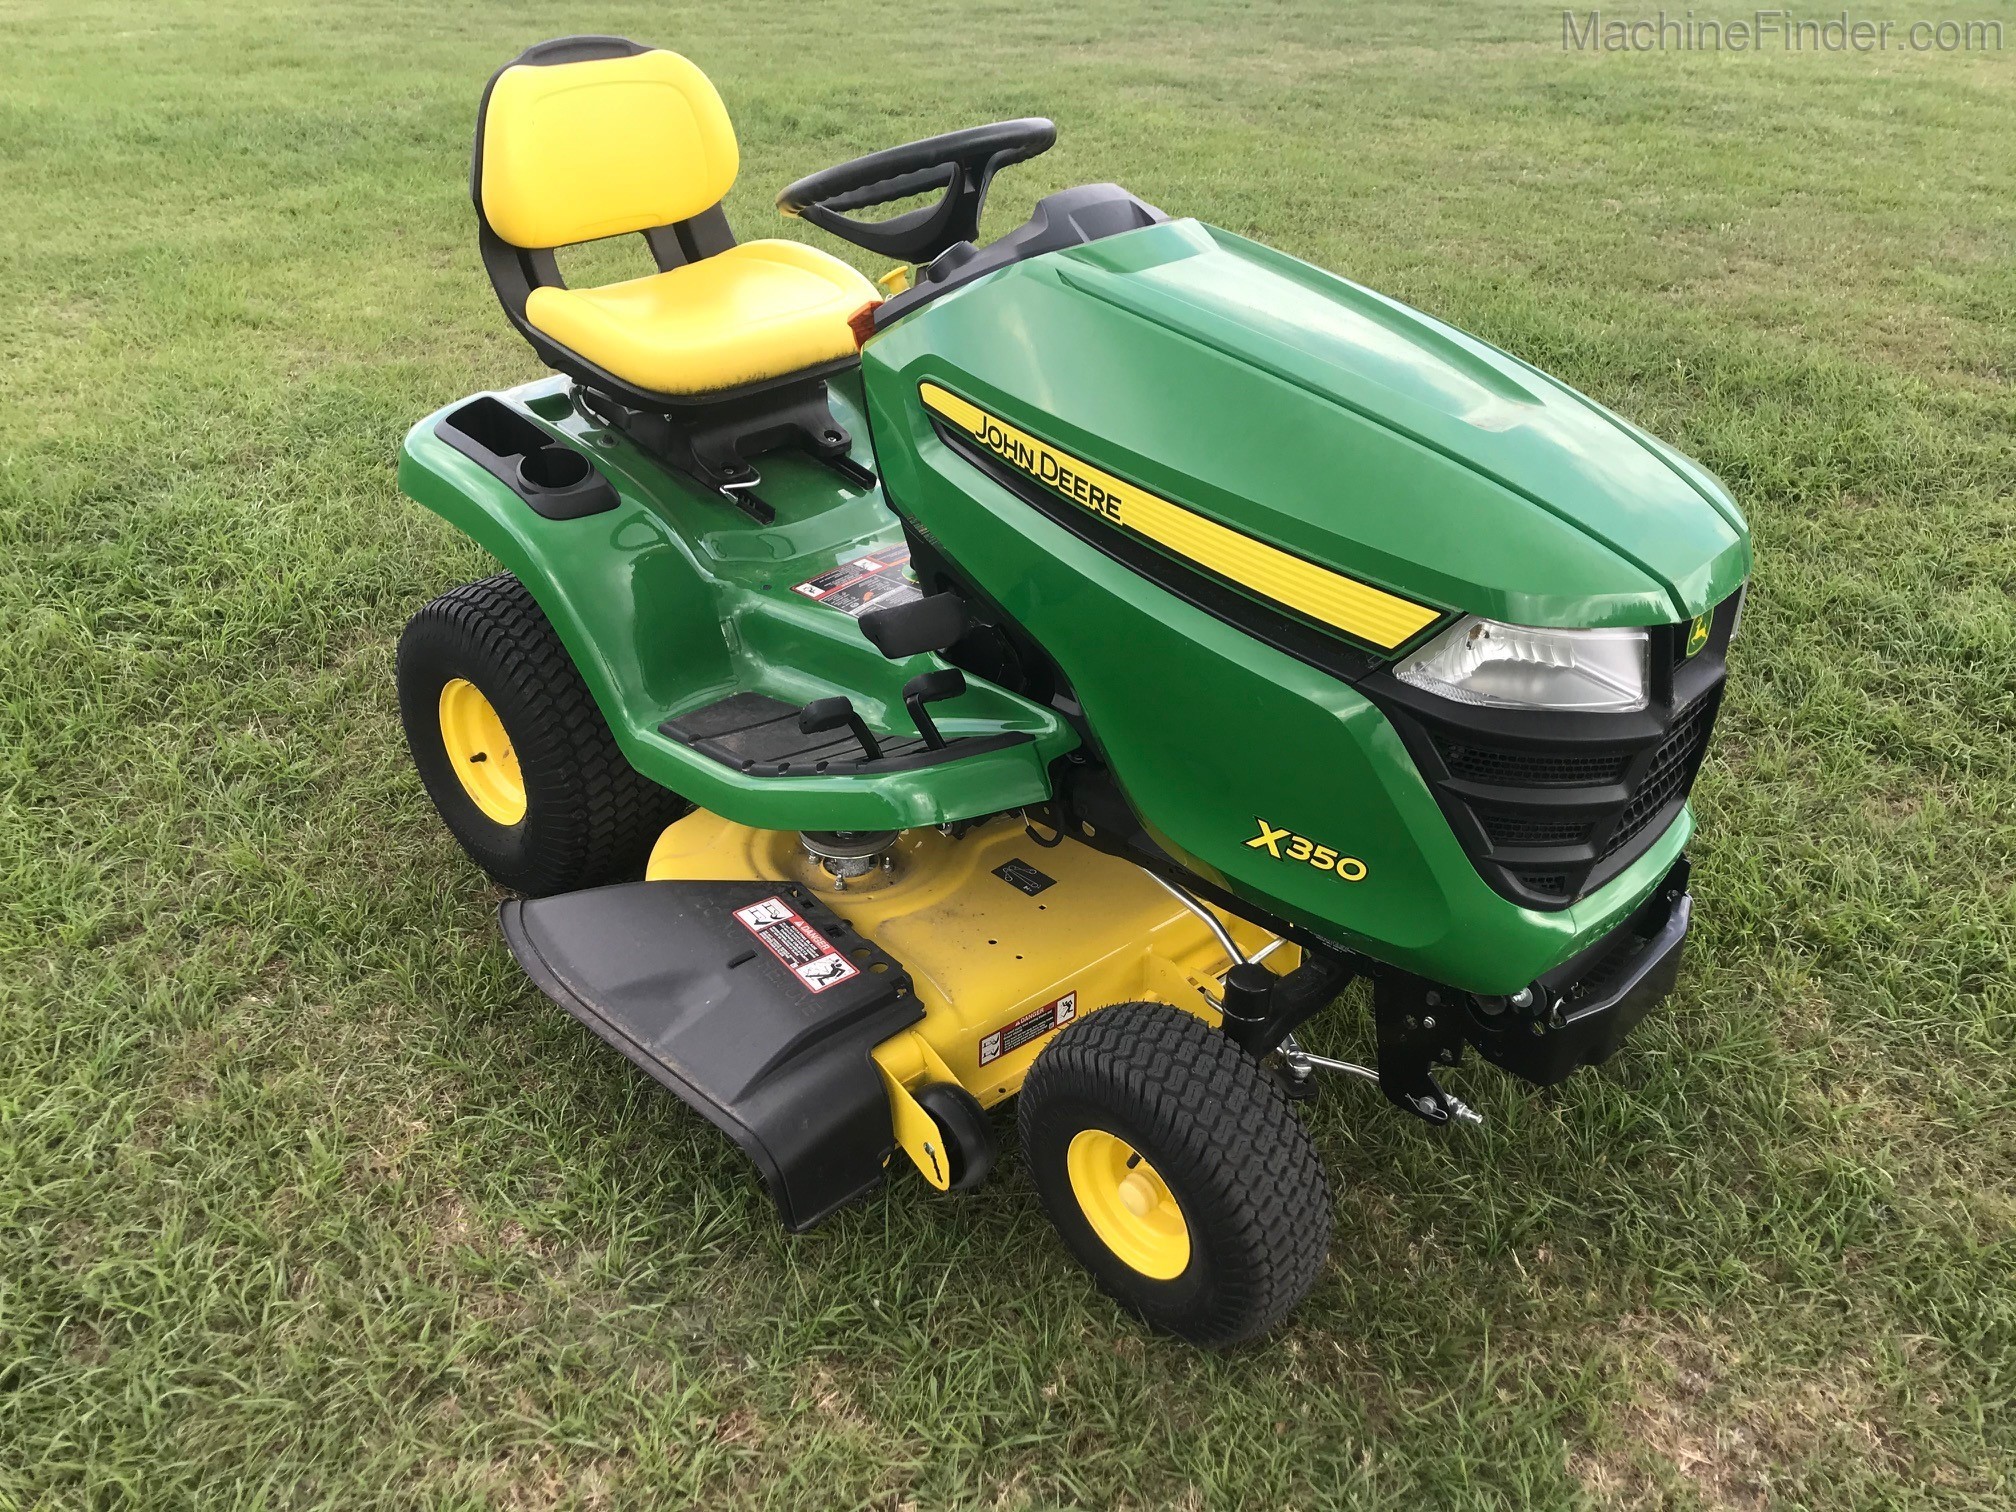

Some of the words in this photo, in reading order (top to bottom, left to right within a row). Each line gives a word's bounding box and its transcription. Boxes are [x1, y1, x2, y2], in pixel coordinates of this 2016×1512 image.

[974, 415, 1035, 471] JOHN
[1040, 450, 1122, 521] DEERE
[1245, 818, 1367, 881] X350
[801, 925, 831, 951] DANGER
[1020, 1007, 1045, 1024] DANGER
